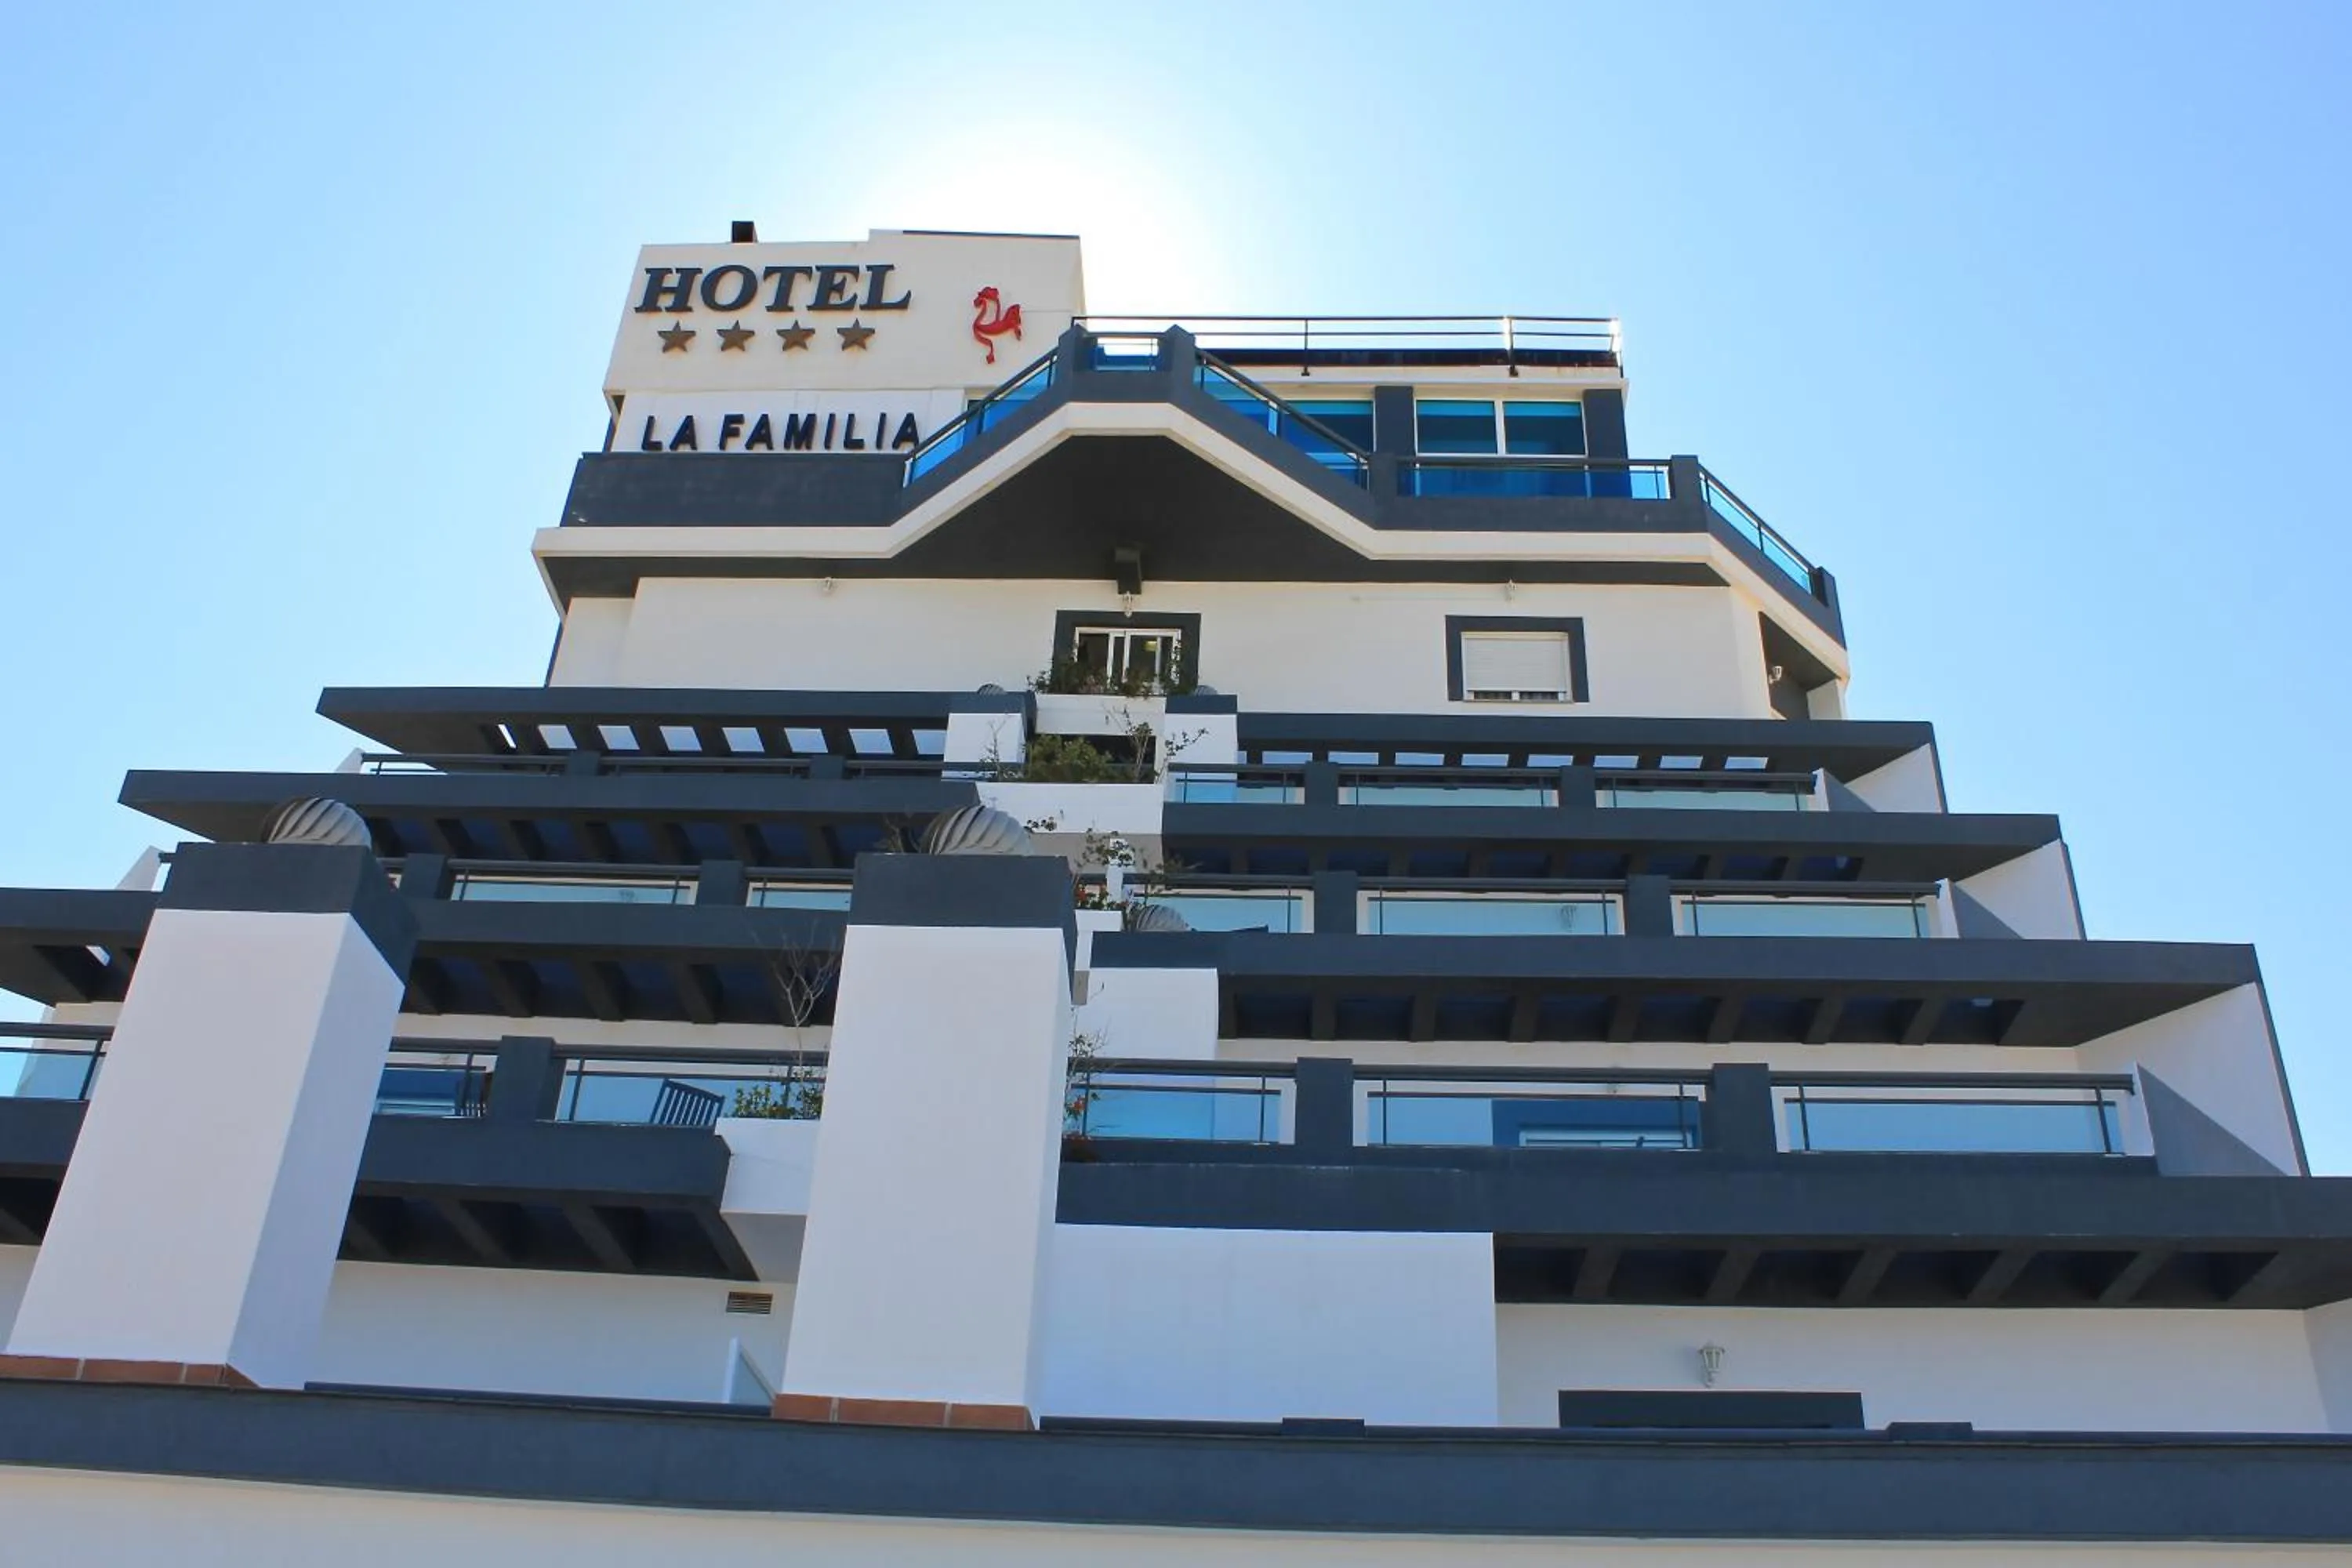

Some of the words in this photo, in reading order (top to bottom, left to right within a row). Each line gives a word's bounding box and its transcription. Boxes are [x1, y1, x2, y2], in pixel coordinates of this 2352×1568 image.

[634, 264, 912, 312] HOTEL
[641, 415, 698, 451] LA
[718, 412, 920, 451] FAMILIA
